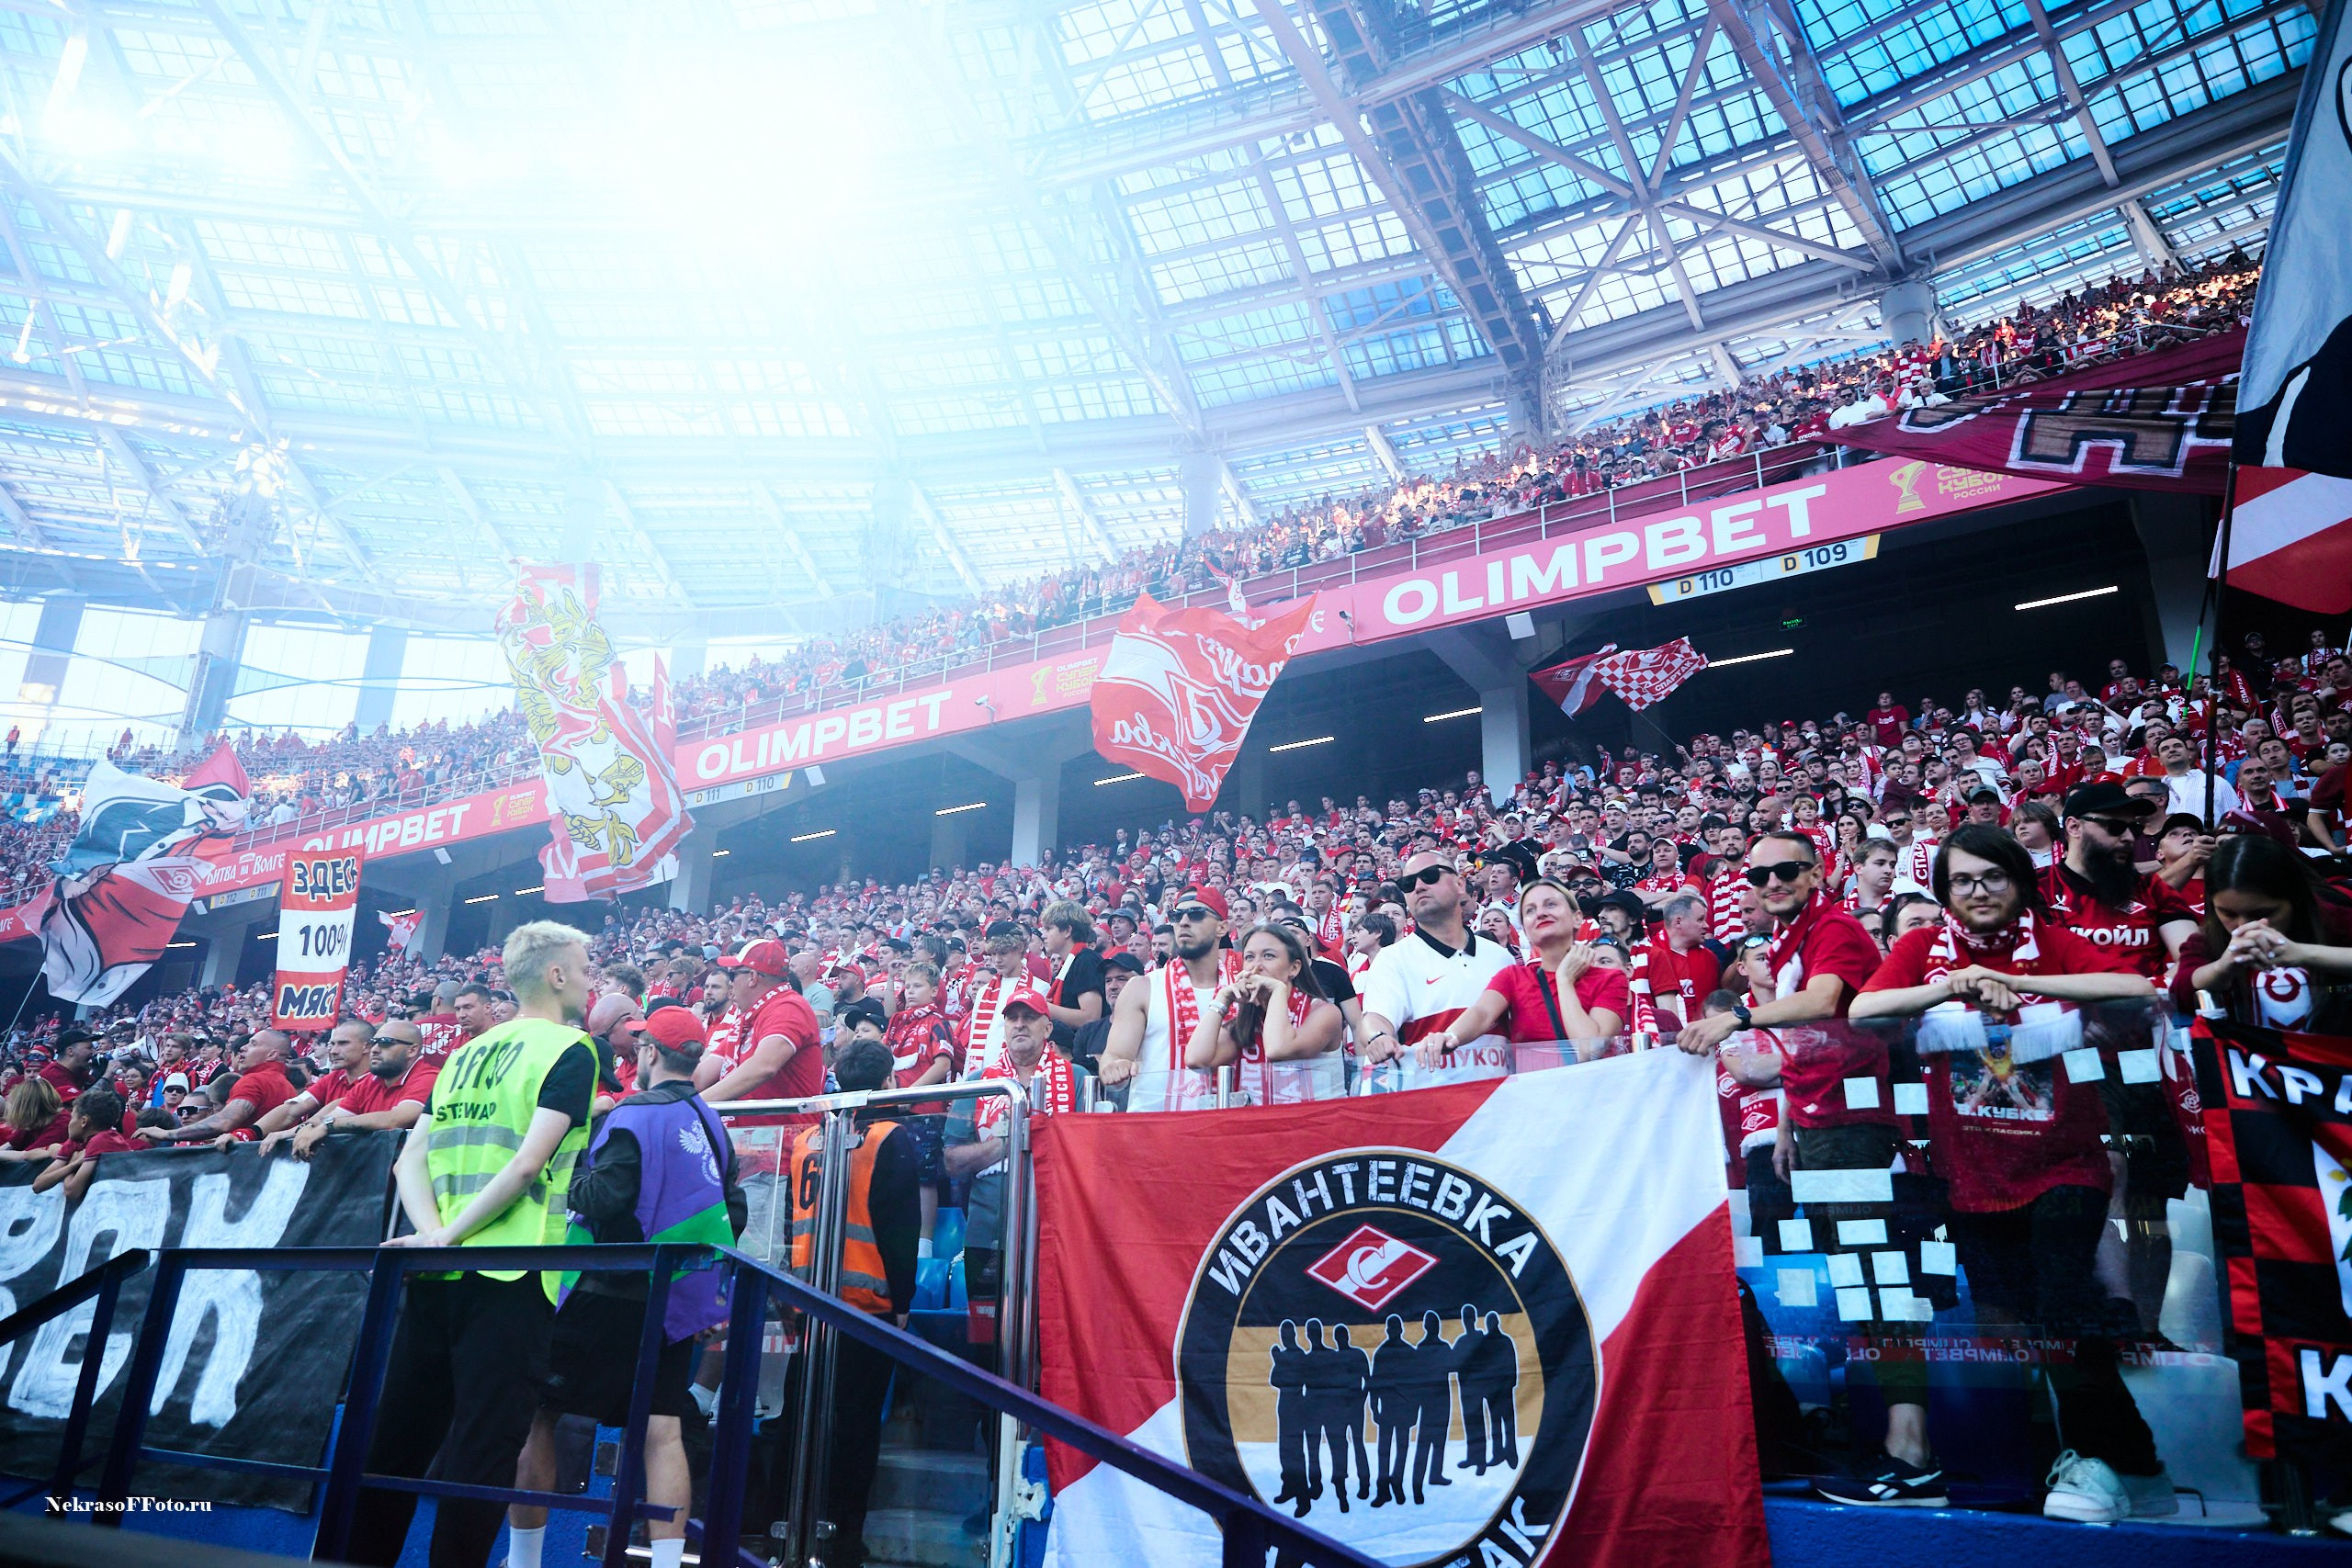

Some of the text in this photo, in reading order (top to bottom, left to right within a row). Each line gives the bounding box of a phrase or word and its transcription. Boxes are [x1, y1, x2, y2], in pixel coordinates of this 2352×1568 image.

[1953, 483, 2001, 500] РОССИИ
[1383, 483, 1826, 626] OLIMPBET
[1679, 580, 1692, 595] D
[1699, 569, 1734, 592] 110
[1783, 556, 1797, 571] D
[1804, 543, 1848, 568] 109
[1655, 658, 1694, 692] СПАРТАК
[696, 690, 953, 780] OLIMPBET
[707, 788, 720, 802] 111
[757, 776, 775, 792] 110
[1208, 1160, 1539, 1297] ИВАНТЕЕВКА
